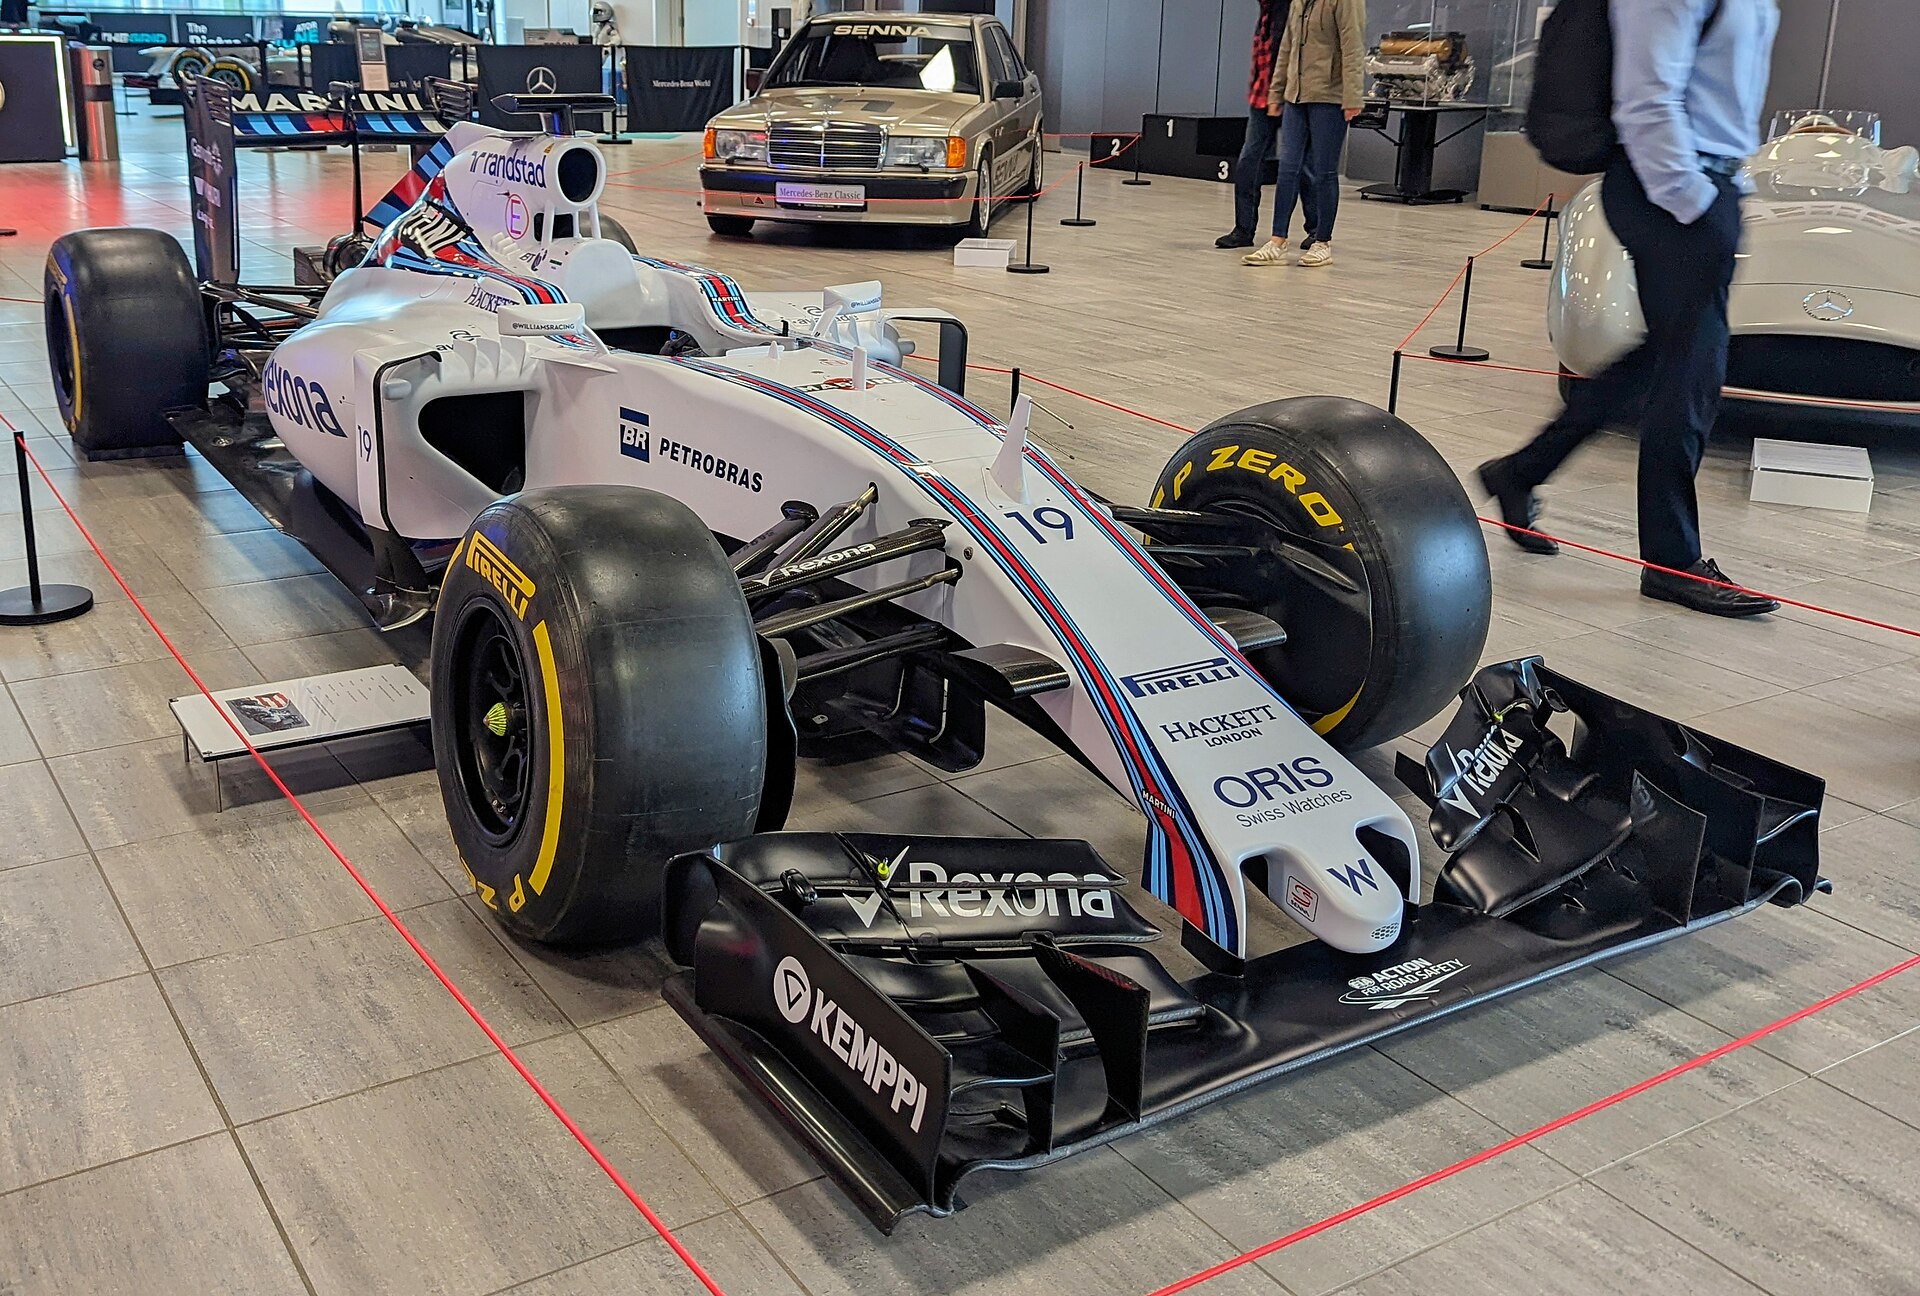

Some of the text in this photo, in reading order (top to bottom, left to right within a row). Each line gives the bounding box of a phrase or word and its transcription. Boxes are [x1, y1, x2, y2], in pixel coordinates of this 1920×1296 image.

[186, 22, 208, 34] The
[833, 25, 932, 36] SENNA
[231, 93, 423, 112] MARINI
[1110, 138, 1121, 157] 2
[1166, 119, 1174, 138] 1
[484, 148, 547, 189] randstad
[1217, 160, 1229, 180] 3
[779, 187, 861, 200] Mercedes-Benz Classic
[512, 322, 575, 331] @WILLIAMSRACING
[357, 424, 372, 462] 19
[622, 426, 763, 493] BR PETROBRAS
[1206, 444, 1343, 527] ZERO
[1003, 506, 1074, 544] 19
[465, 530, 536, 622] PIRELLI
[779, 543, 877, 577] Rexona
[1119, 656, 1240, 699] PIRELLI
[1159, 704, 1277, 743] HACKETT
[1204, 727, 1263, 748] LONDON
[1213, 756, 1334, 808] ORIS
[1142, 788, 1176, 820] MARTINI
[1236, 787, 1353, 828] Swiss Watches
[908, 862, 1115, 919] Rexona
[1326, 858, 1379, 896] W
[1360, 958, 1464, 996] FOR ROAD SAFETY
[1371, 957, 1433, 983] ACTION
[810, 987, 928, 1133] KEMPPI
